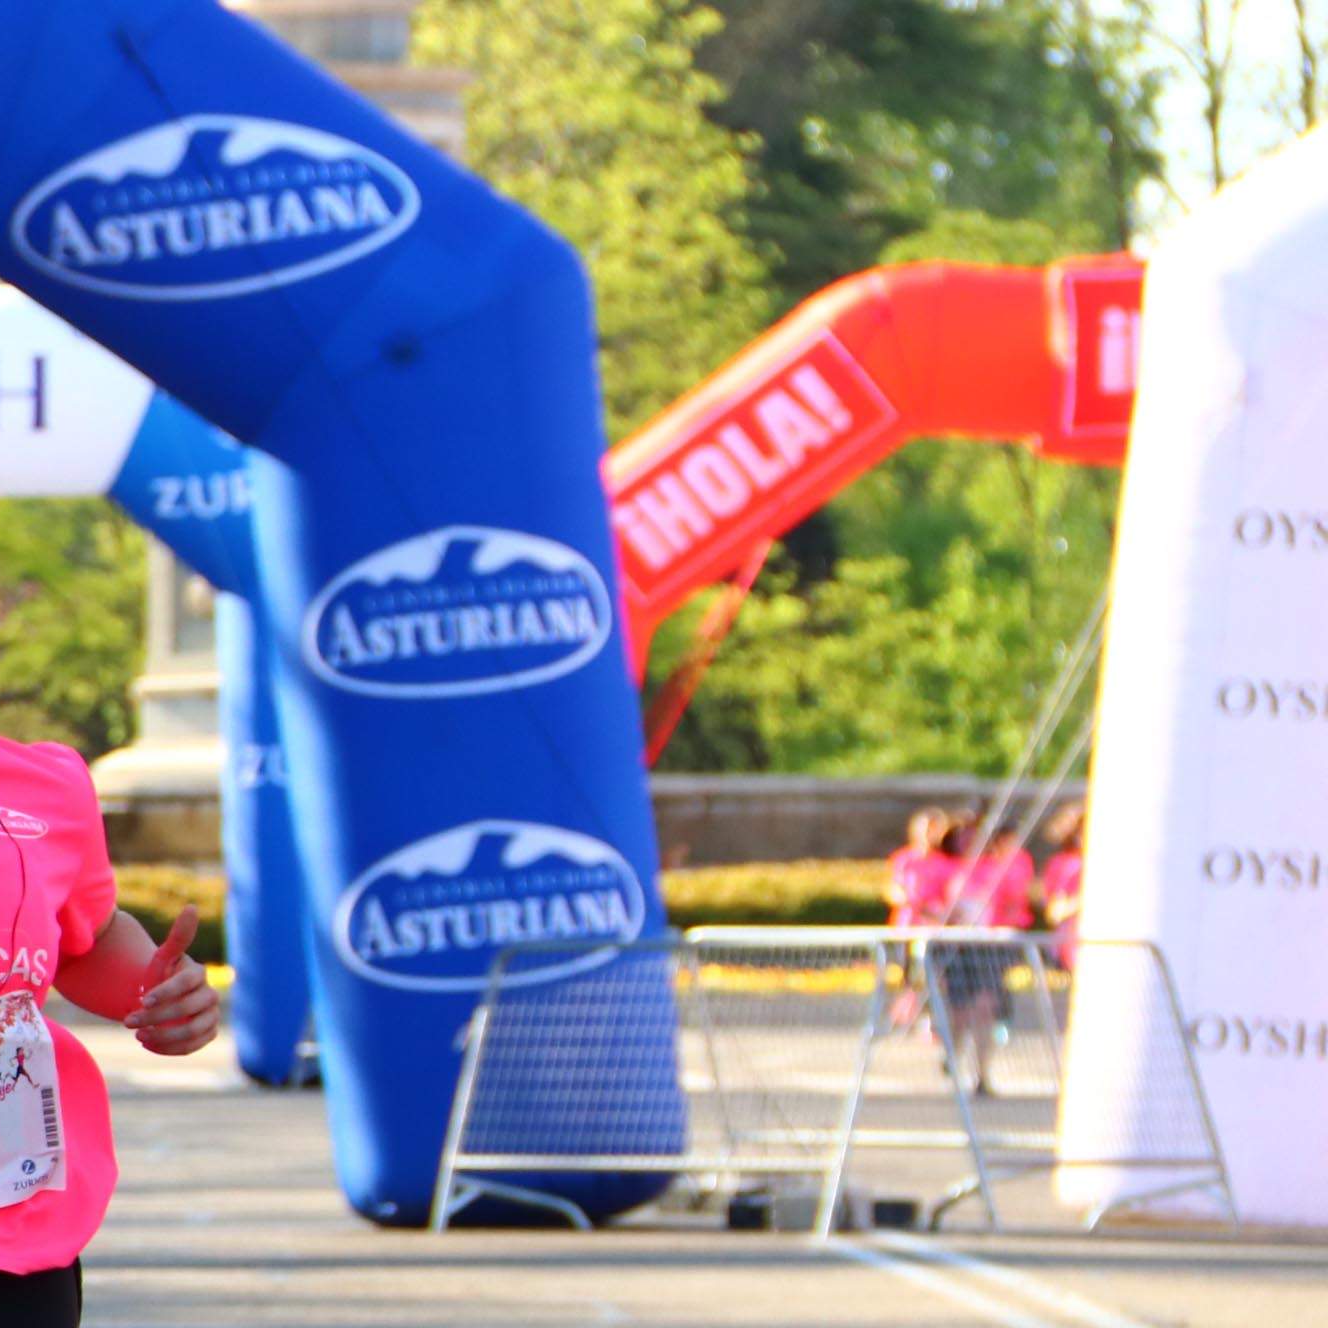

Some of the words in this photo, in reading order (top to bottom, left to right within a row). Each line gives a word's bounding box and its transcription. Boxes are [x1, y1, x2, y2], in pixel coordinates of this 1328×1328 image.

[51, 180, 395, 266] ASTURIANA
[327, 597, 596, 668] ASTURIANA
[1217, 675, 1328, 720] OYS
[358, 889, 629, 960] ASTURIANA
